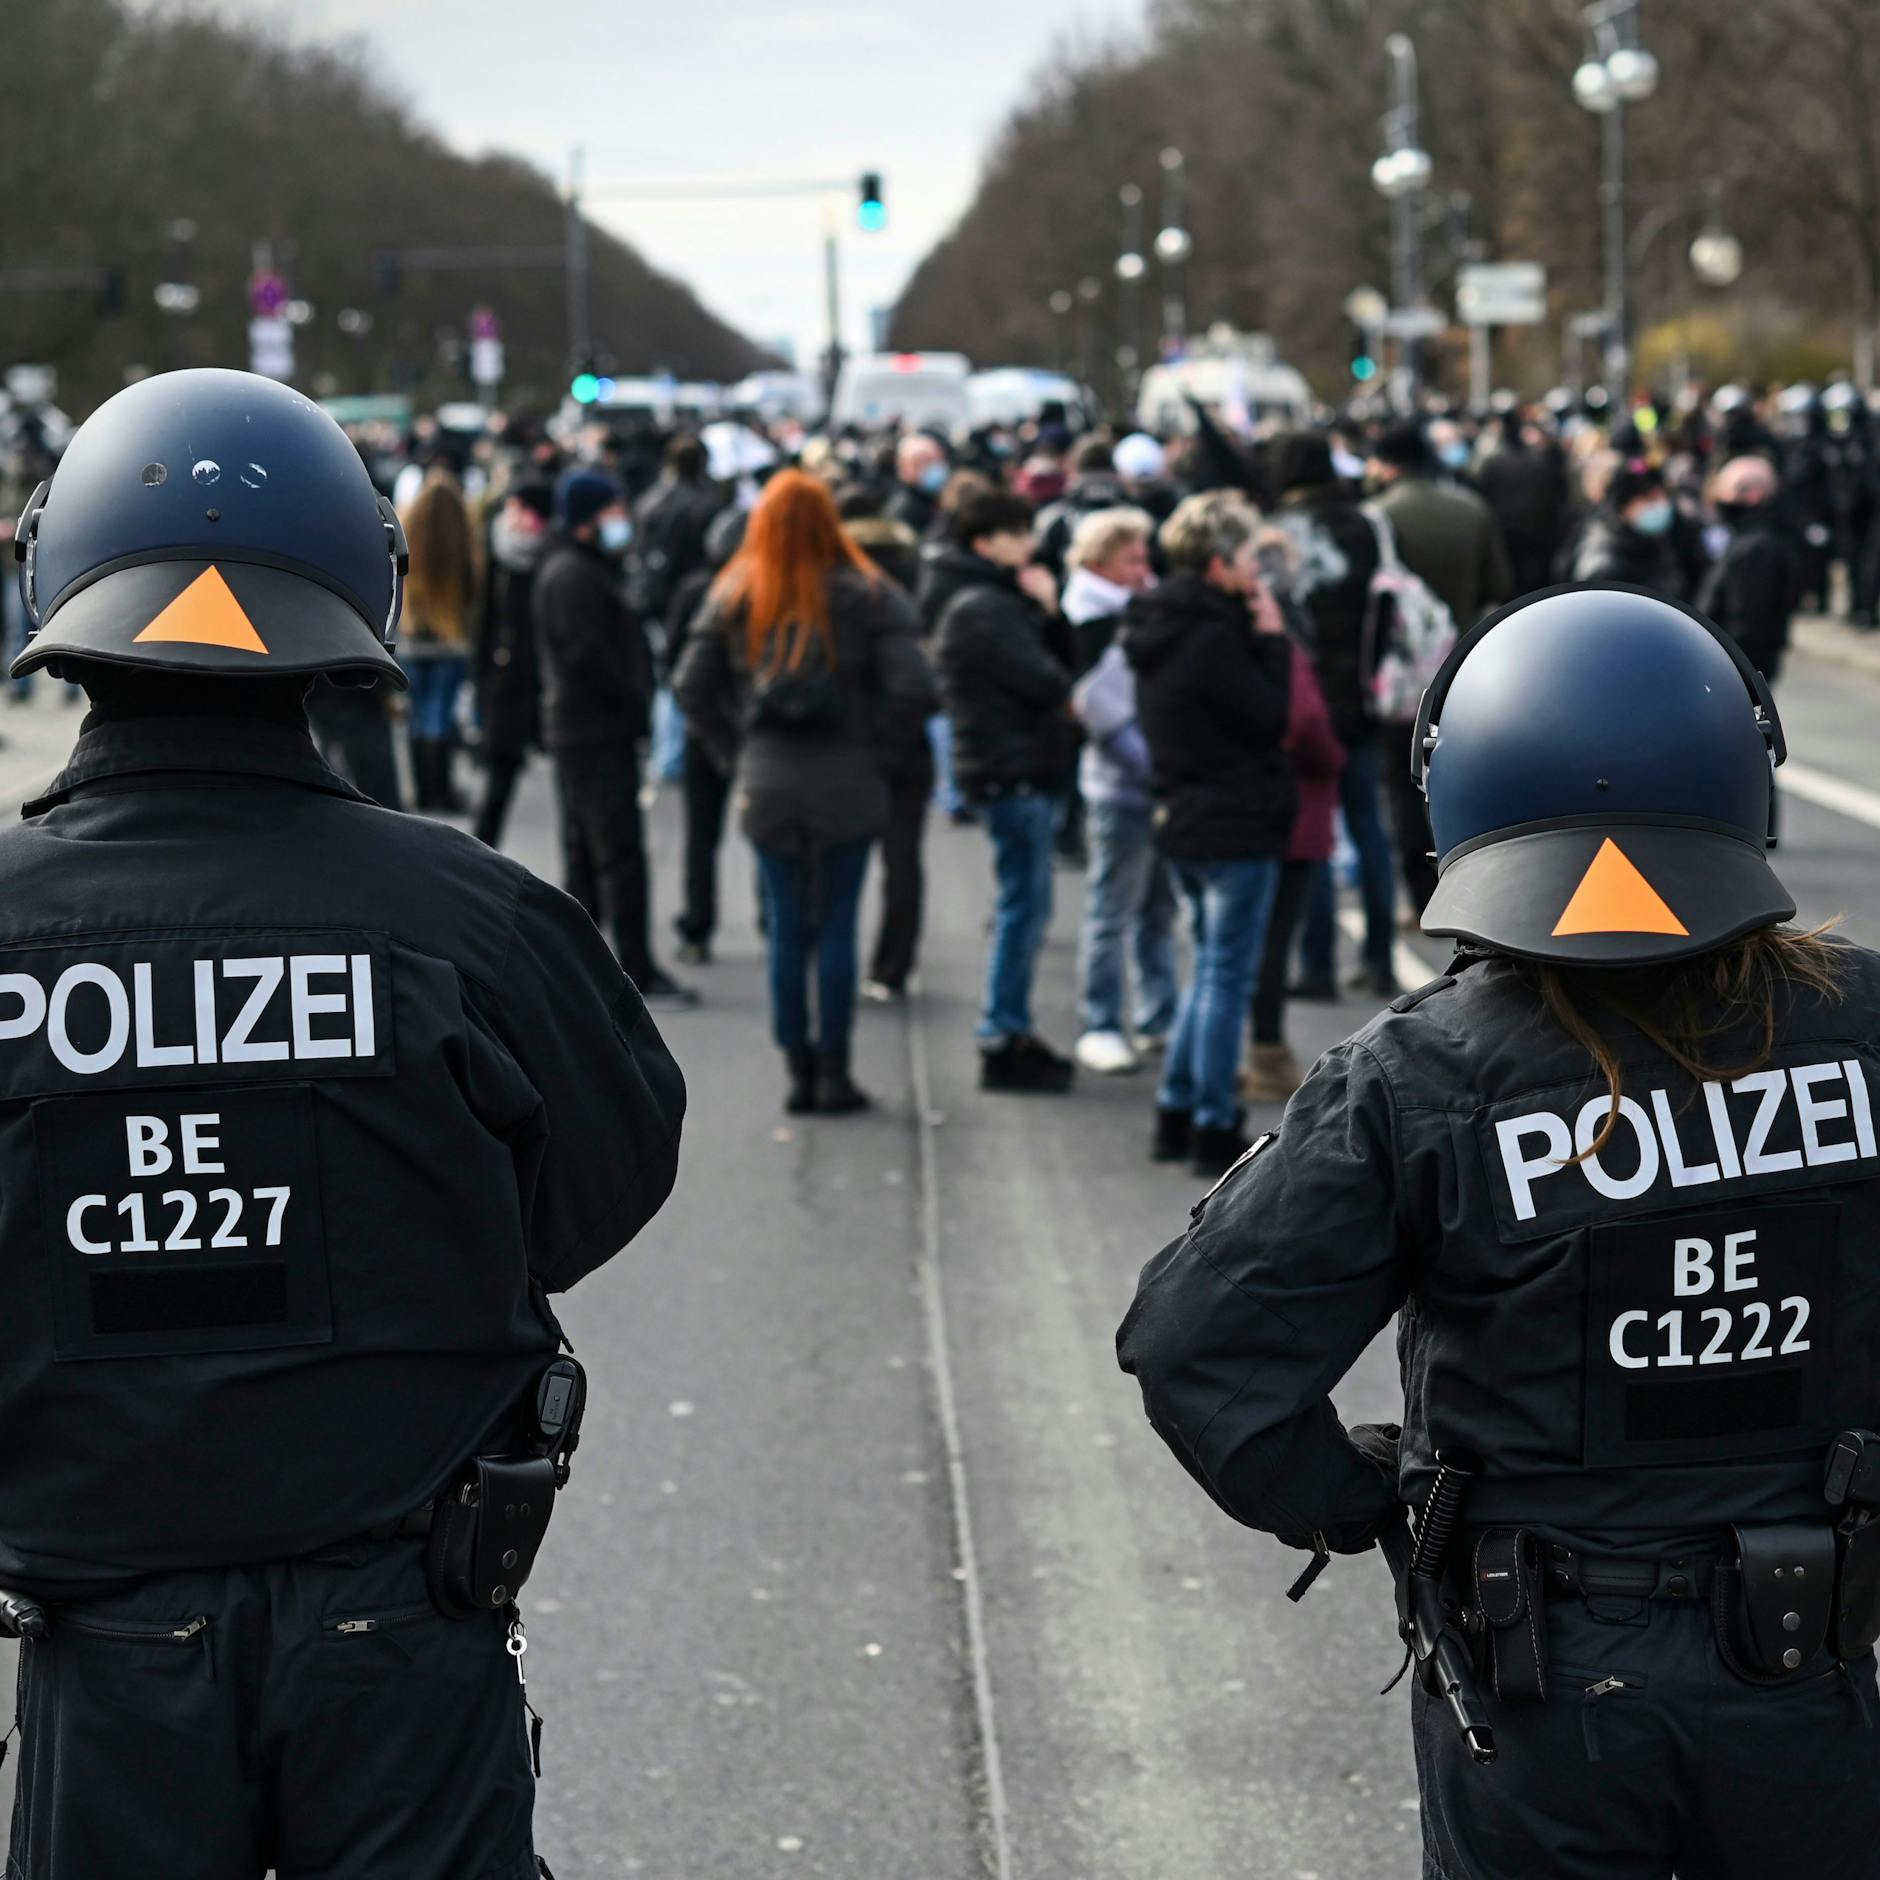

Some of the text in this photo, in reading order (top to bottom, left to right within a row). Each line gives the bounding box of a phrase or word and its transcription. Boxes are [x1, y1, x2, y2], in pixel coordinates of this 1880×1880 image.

[125, 1113, 225, 1177] BE
[1494, 1059, 1878, 1221] POLIZEI
[66, 1186, 291, 1255] C1227
[1673, 1229, 1758, 1297] BE
[1609, 1295, 1811, 1369] C1222
